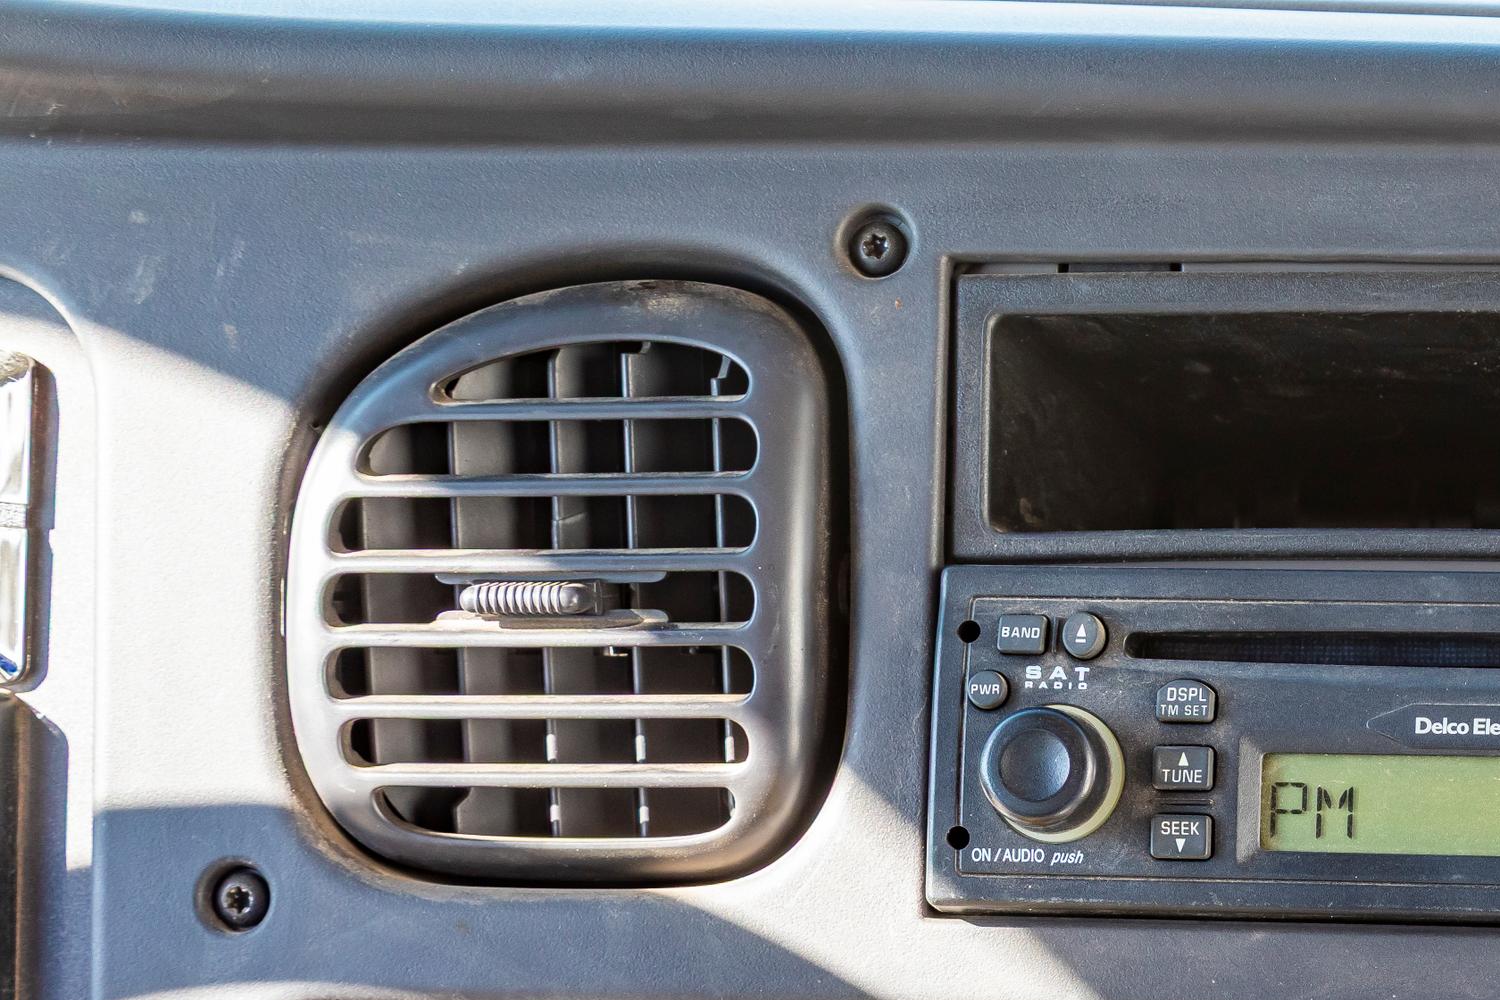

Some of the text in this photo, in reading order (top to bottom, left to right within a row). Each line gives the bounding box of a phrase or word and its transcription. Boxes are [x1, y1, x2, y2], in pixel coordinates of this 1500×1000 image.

[1001, 626, 1040, 639] BAND
[1025, 665, 1090, 681] SAT
[970, 684, 1000, 695] PWR
[1024, 681, 1088, 689] RADIO
[1166, 687, 1206, 702] DSPL
[1160, 704, 1207, 716] TM SET
[1415, 717, 1469, 735] Delco
[1162, 769, 1203, 784] TUNE
[1270, 781, 1355, 840] PM
[1160, 821, 1199, 836] SEEK
[1050, 849, 1084, 866] push
